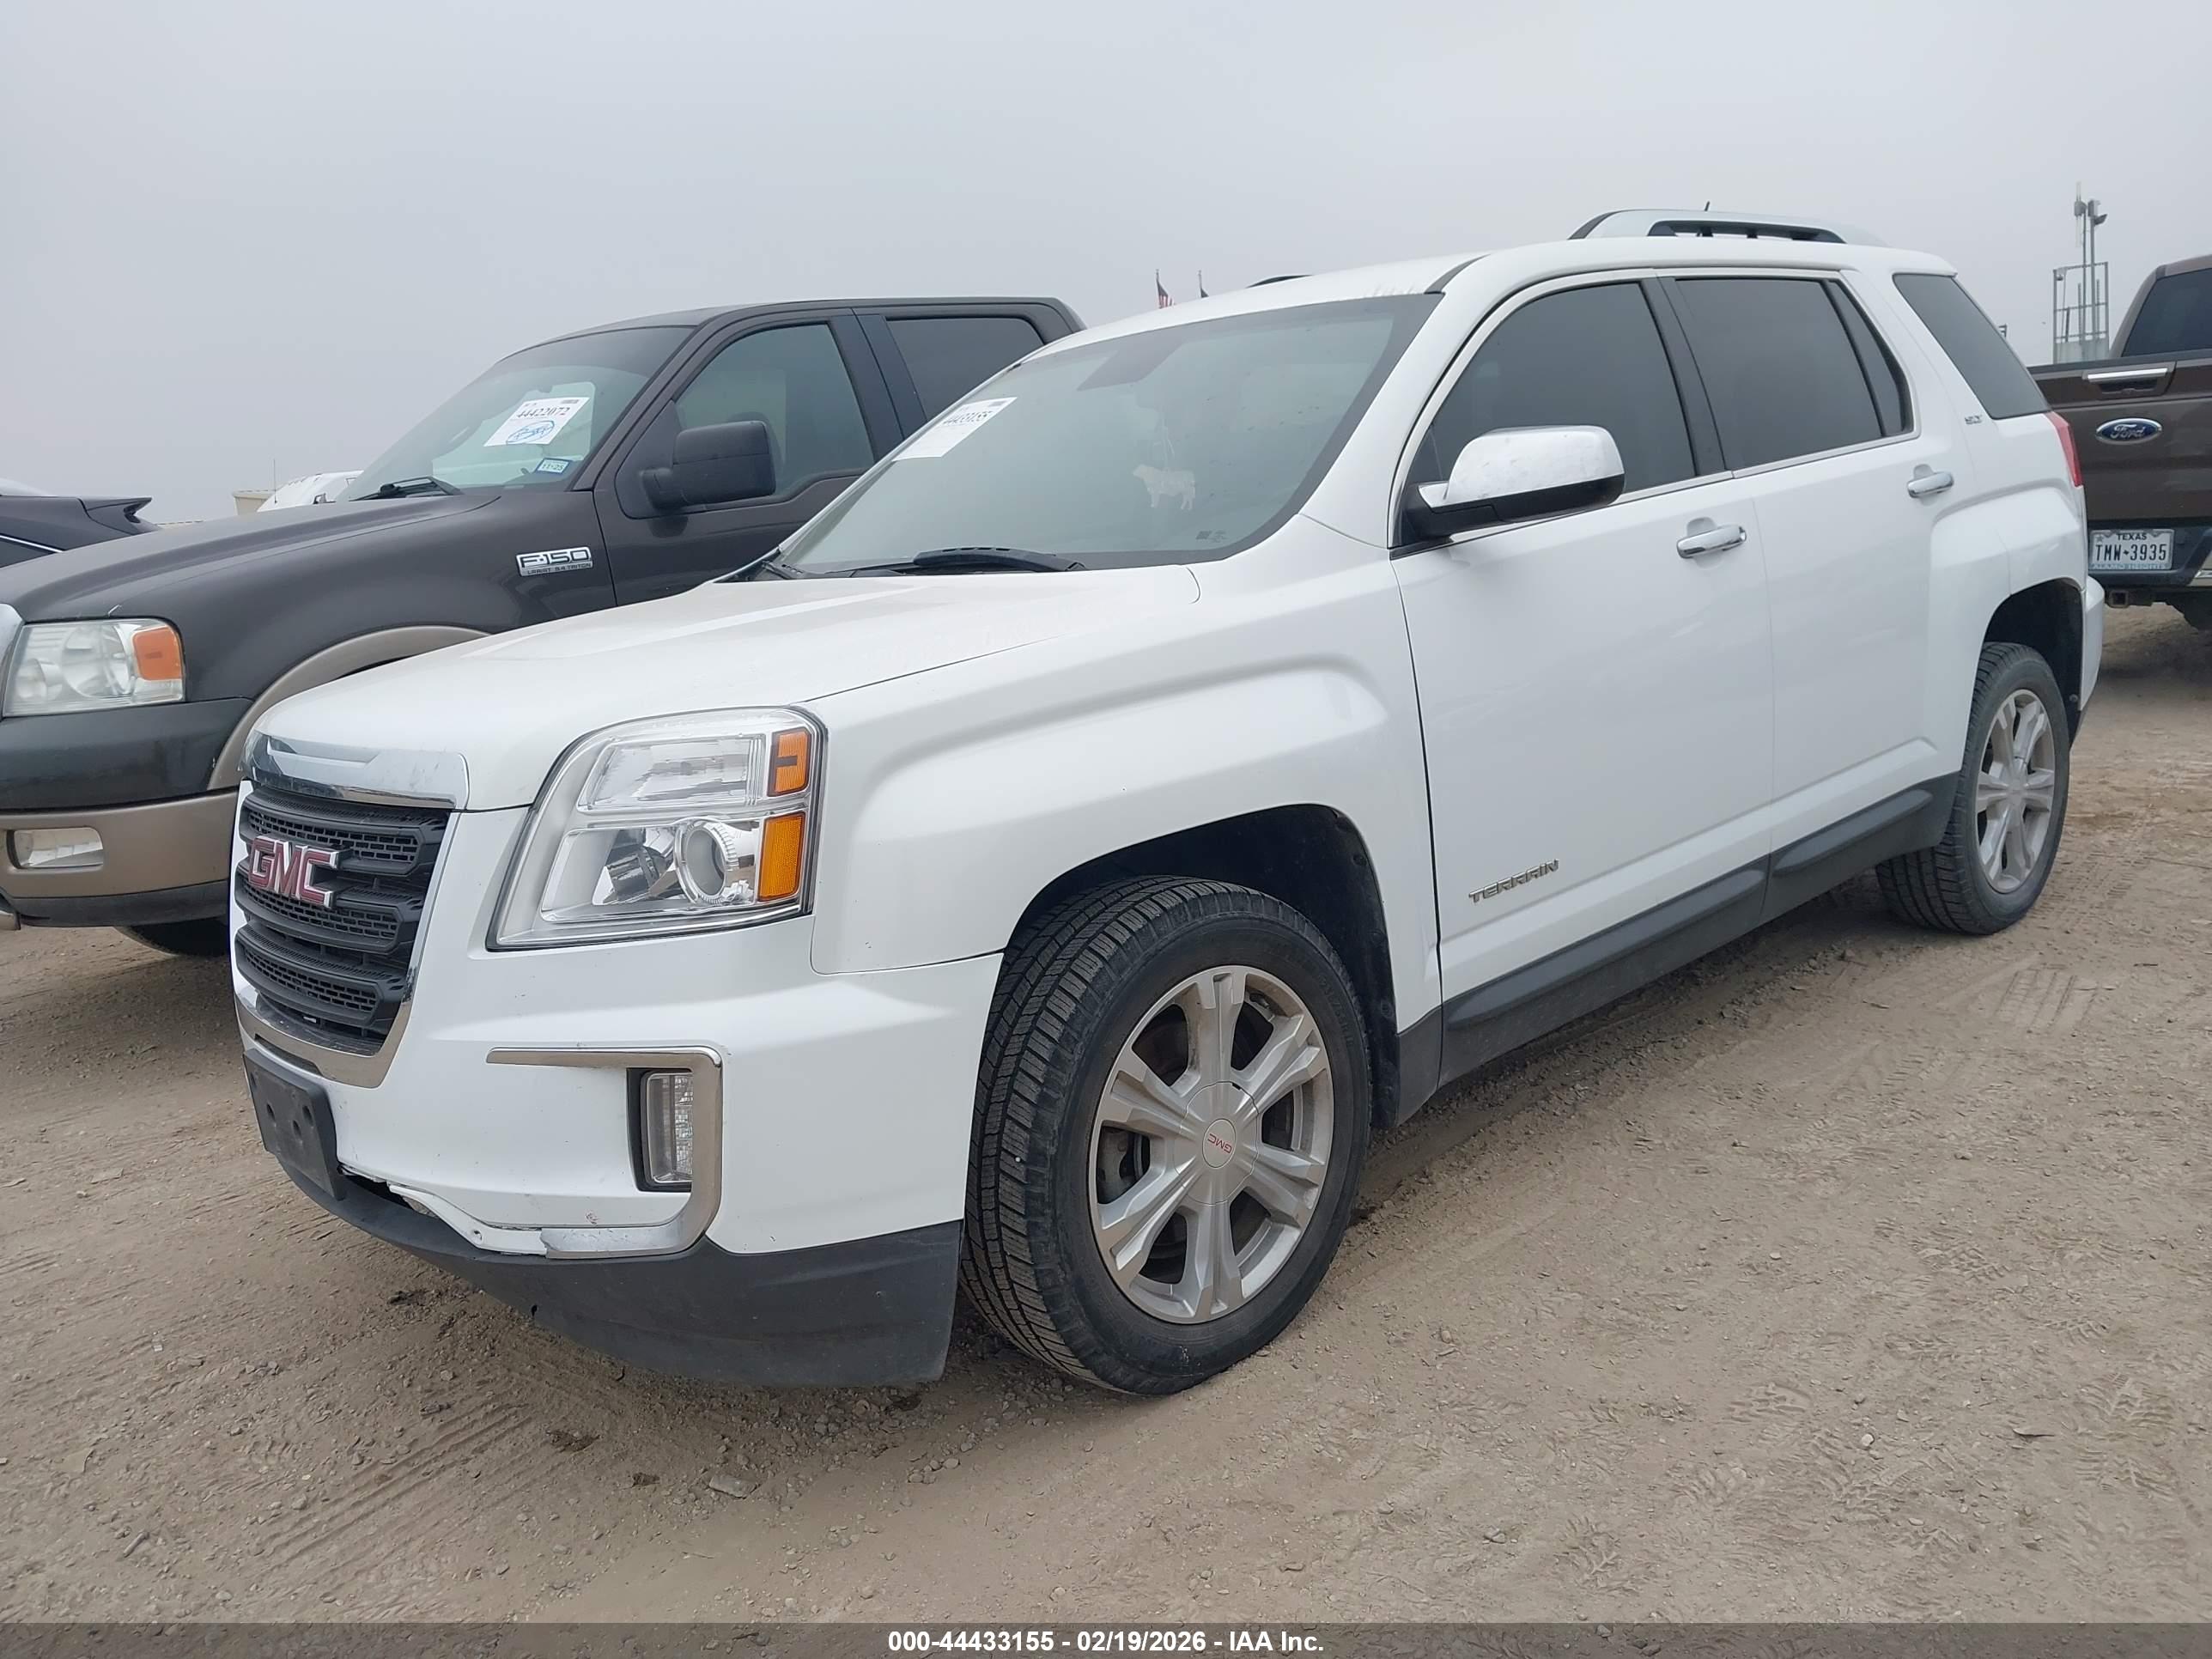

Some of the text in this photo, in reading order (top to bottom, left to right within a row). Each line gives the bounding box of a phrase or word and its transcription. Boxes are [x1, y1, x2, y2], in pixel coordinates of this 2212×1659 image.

[2110, 423, 2147, 439] Ford
[2116, 532, 2147, 541] TEXAS
[248, 836, 340, 909] GMC
[1468, 859, 1559, 903] TERRAIN
[1207, 1133, 1233, 1154] GMC
